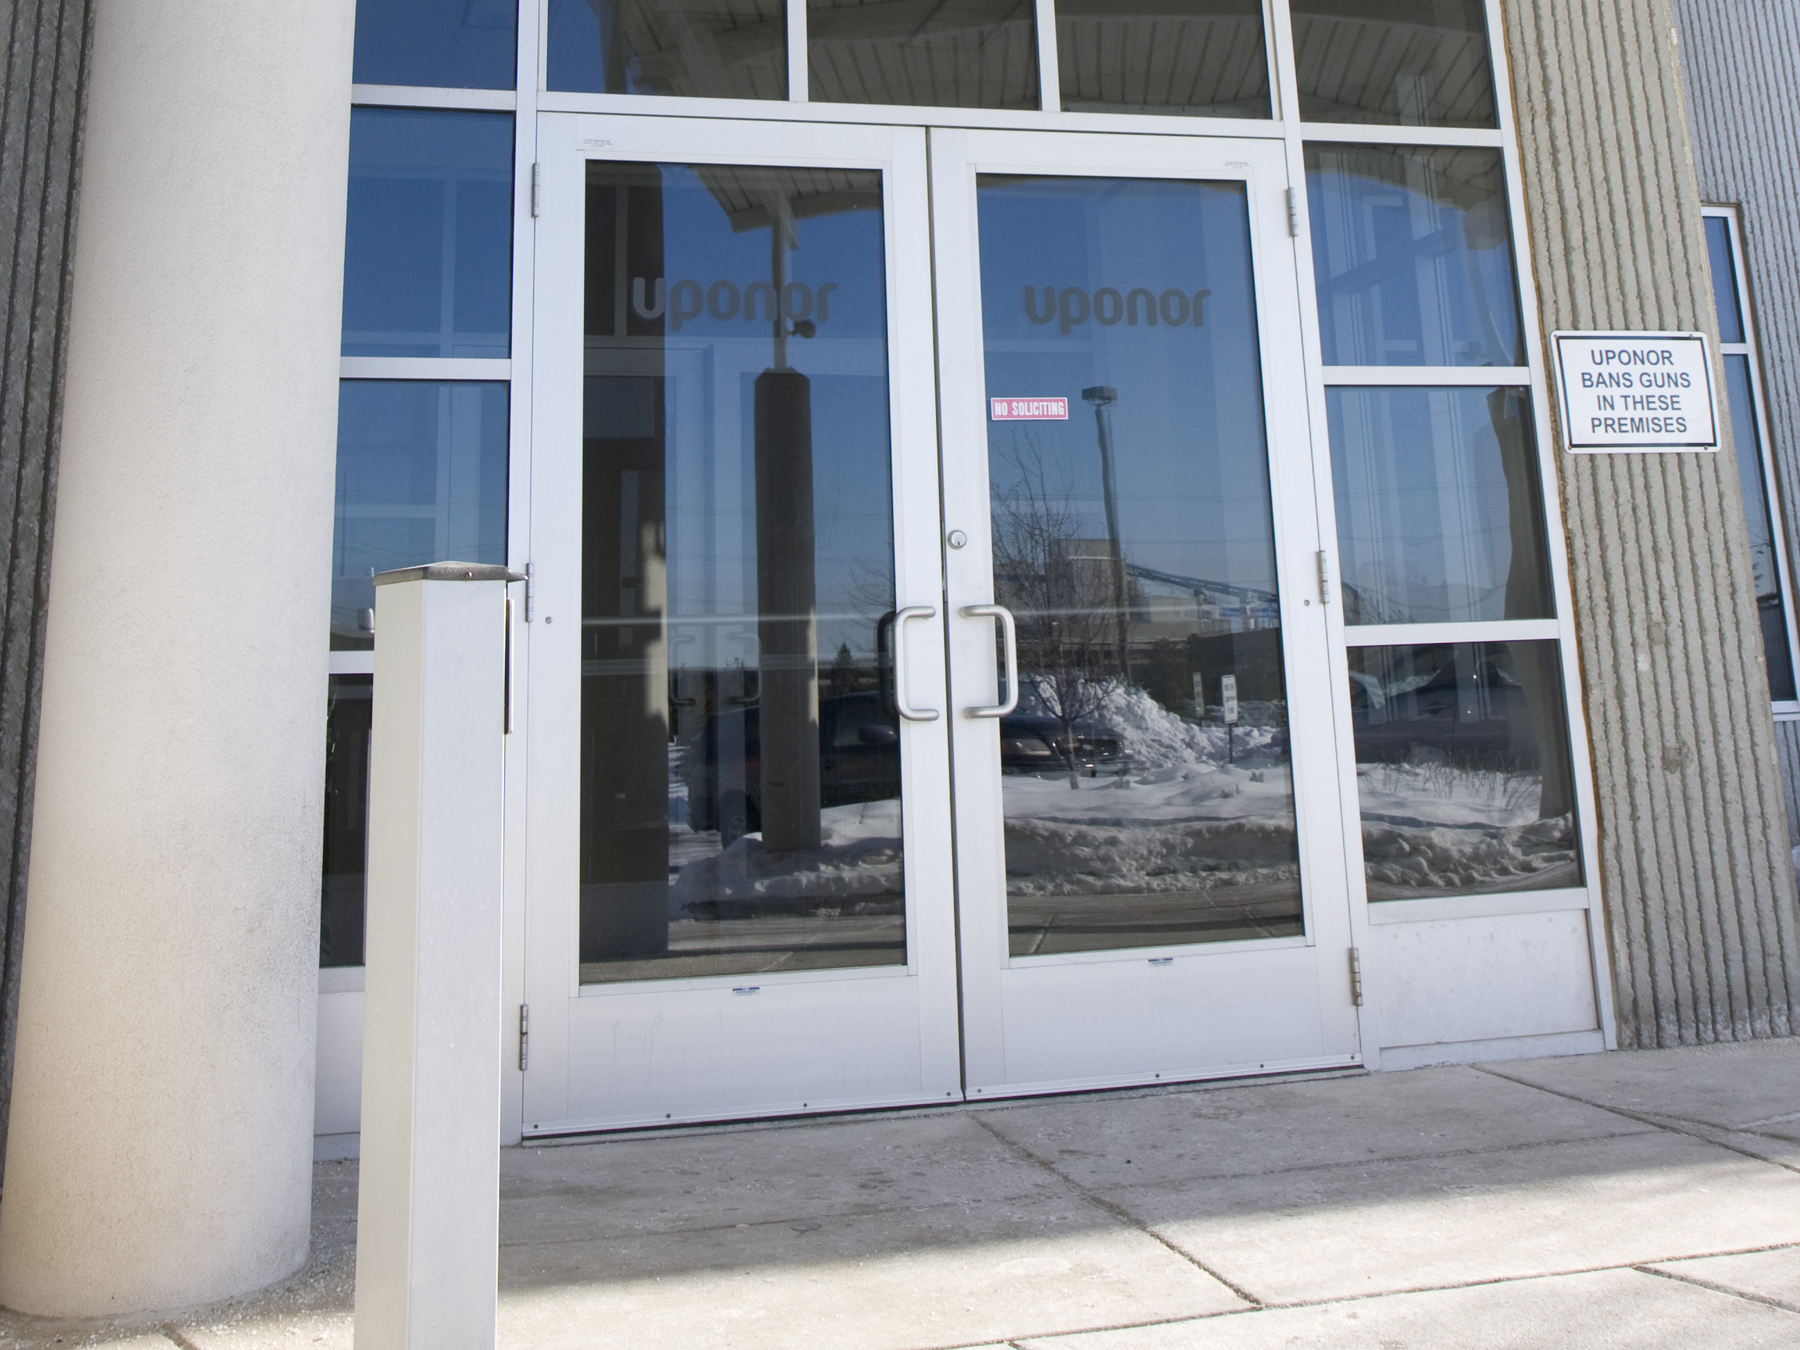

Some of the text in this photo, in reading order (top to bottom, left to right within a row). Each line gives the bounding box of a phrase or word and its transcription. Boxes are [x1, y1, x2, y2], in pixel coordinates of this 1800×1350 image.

[633, 277, 838, 331] uponor
[1025, 285, 1212, 336] uponor
[1591, 349, 1674, 366] UPONOR
[1581, 372, 1691, 388] BANS GUNS
[994, 401, 1065, 416] NO SOLICITING
[1597, 395, 1682, 411] IN THESE
[1591, 417, 1688, 433] PREMISES
